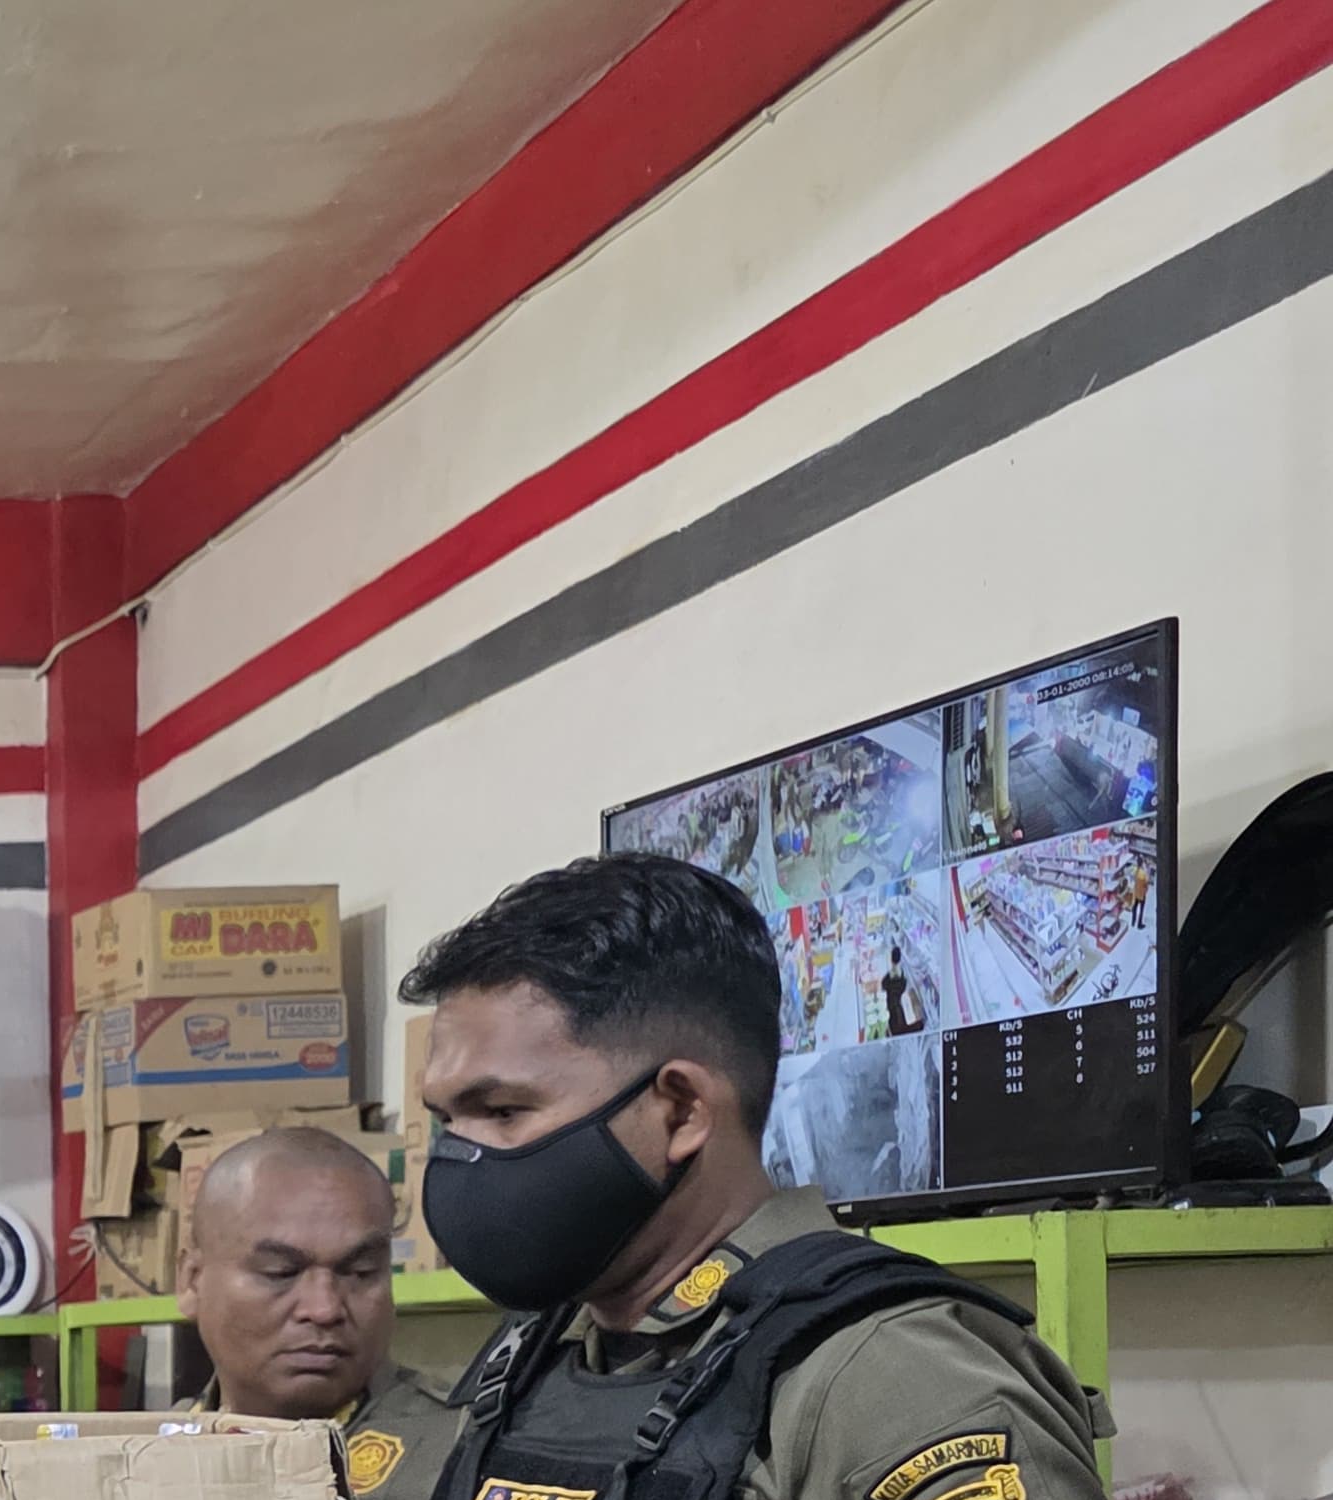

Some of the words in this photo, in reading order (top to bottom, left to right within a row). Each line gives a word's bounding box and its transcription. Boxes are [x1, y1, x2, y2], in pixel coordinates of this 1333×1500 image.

[171, 912, 211, 942] MI
[220, 921, 317, 956] DARA
[171, 944, 213, 956] CAP
[1067, 1009, 1082, 1020] CH
[943, 1031, 958, 1042] CH
